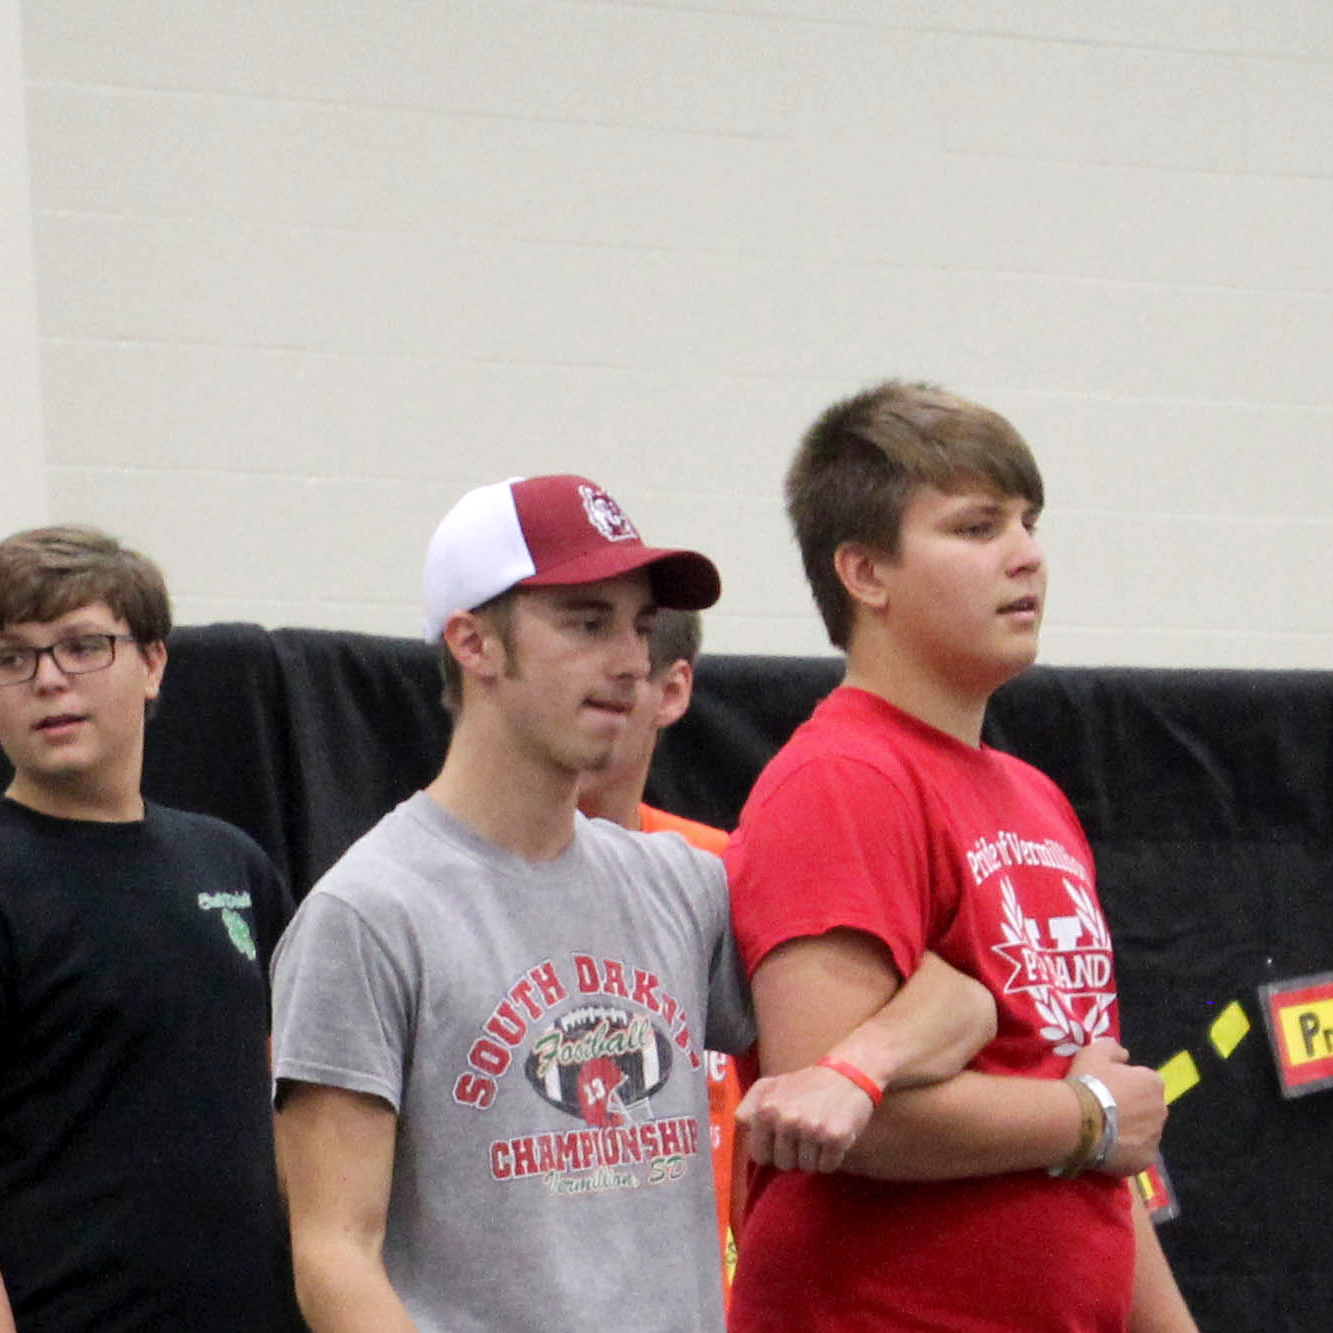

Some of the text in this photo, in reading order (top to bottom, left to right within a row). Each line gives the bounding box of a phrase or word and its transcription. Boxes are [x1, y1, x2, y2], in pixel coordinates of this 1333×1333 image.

[452, 959, 569, 1110] SOUTH
[534, 1015, 653, 1076] Football
[648, 1153, 687, 1184] SD
